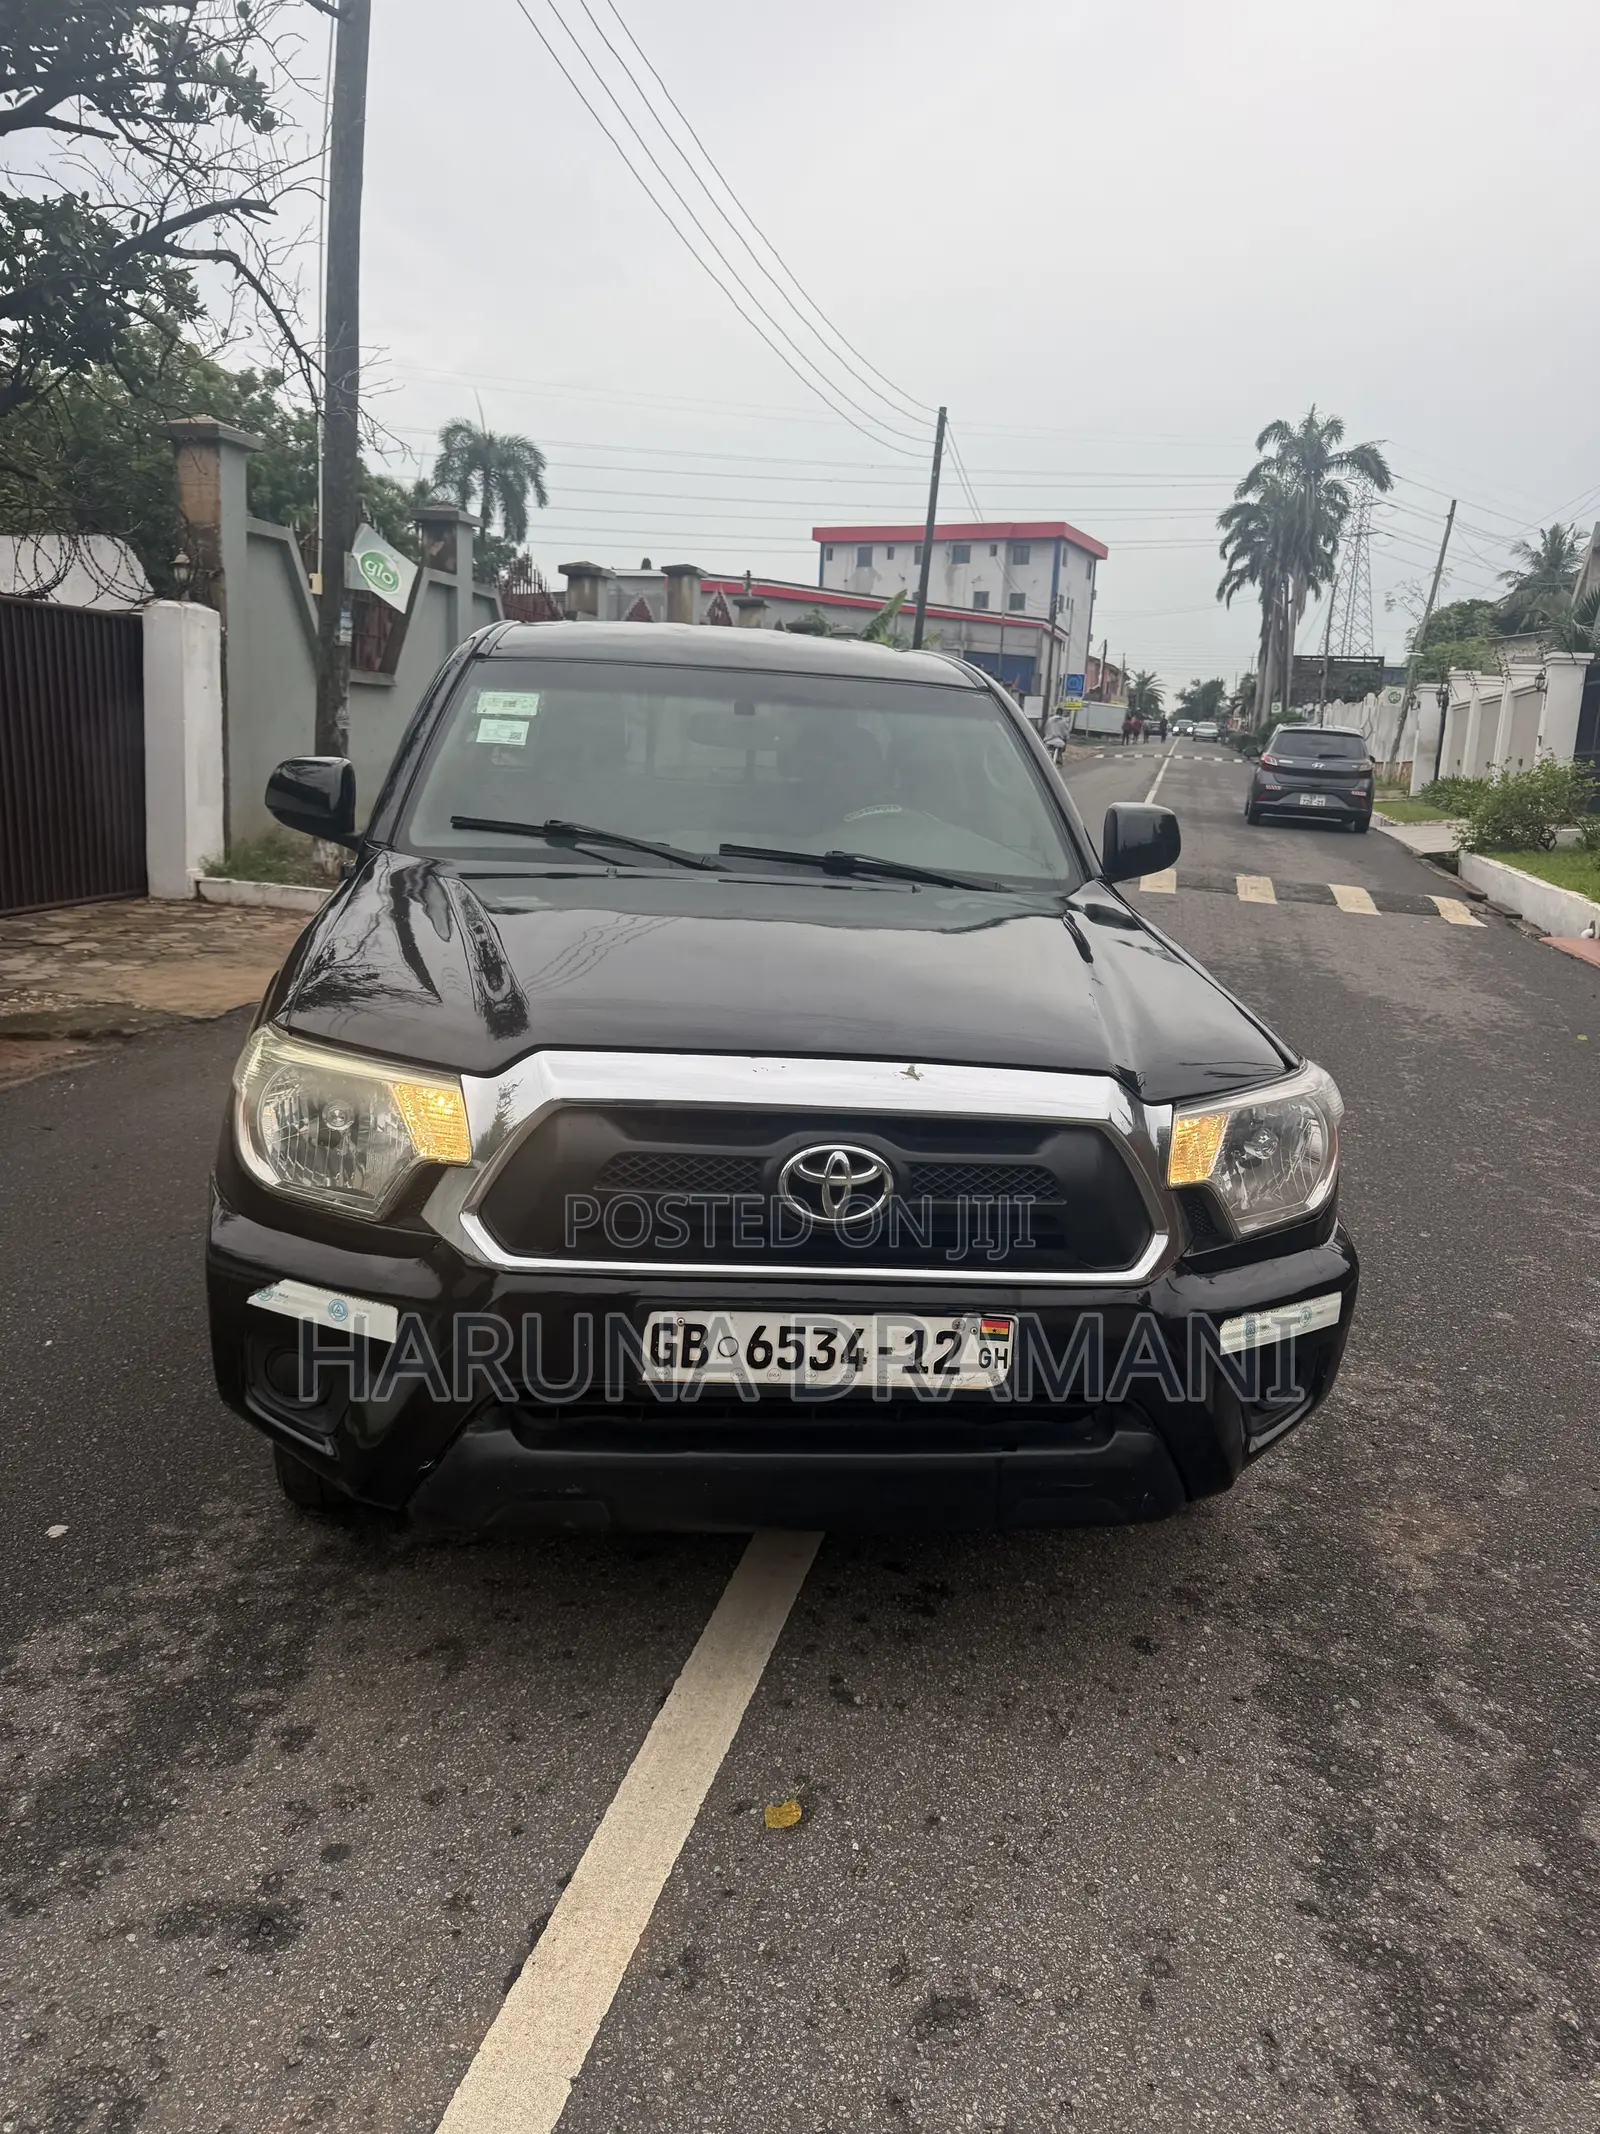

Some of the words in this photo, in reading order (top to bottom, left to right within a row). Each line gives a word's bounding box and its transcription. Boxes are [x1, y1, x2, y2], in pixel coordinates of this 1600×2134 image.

[365, 560, 394, 585] glo
[650, 1323, 710, 1369] GB
[746, 1325, 962, 1375] 6534-12
[979, 1347, 1008, 1369] GH
